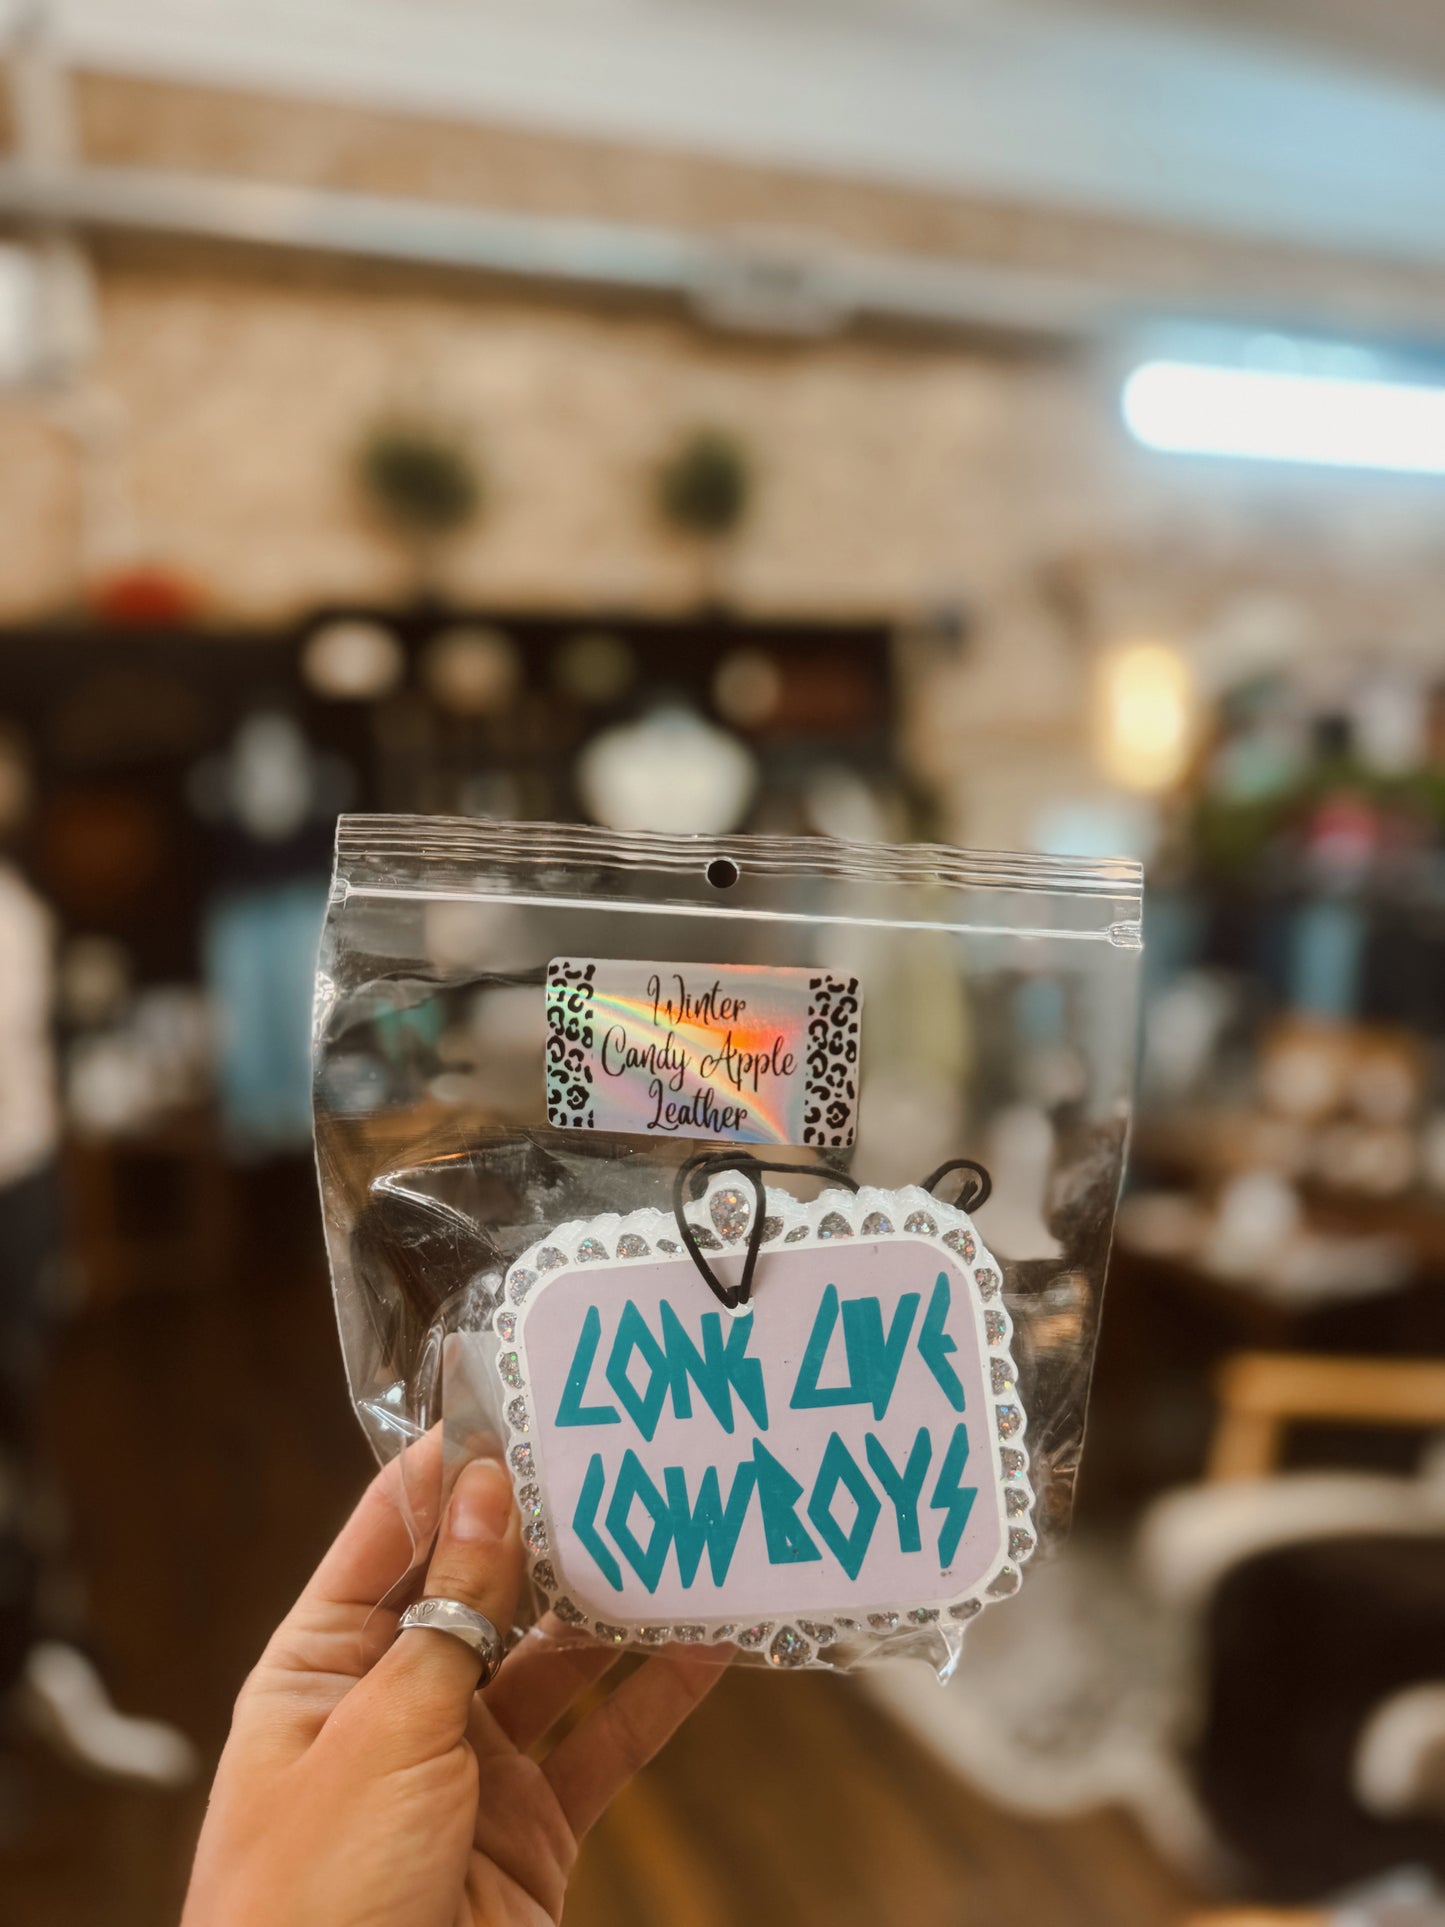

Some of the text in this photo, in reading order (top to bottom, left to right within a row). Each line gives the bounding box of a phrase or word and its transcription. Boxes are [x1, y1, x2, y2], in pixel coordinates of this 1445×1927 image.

[647, 974, 746, 1026] Winter
[601, 1025, 797, 1092] Candy Apple
[647, 1078, 748, 1132] Leather
[554, 1271, 966, 1442] LONG LIVE
[572, 1422, 978, 1595] COWBOYS
